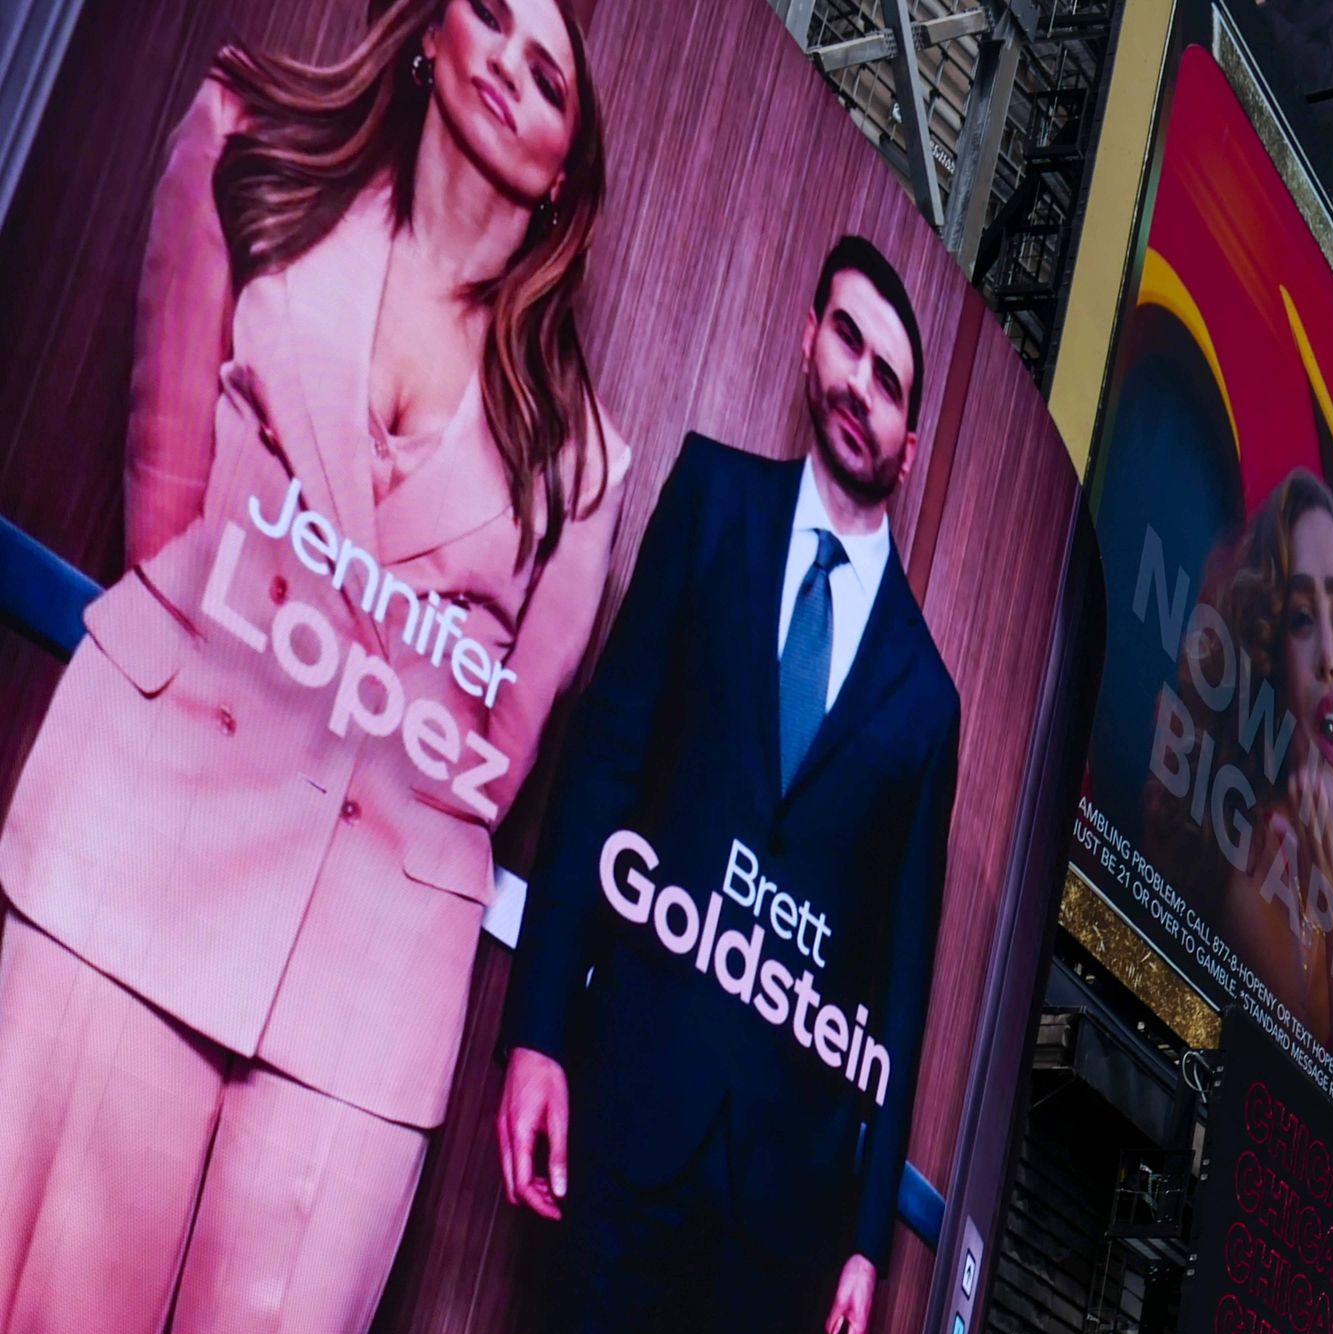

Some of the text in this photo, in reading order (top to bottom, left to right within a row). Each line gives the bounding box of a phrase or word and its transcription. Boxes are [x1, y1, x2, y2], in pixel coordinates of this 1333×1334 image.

[200, 520, 511, 821] Lopez
[249, 477, 518, 709] Jennifer
[1132, 523, 1298, 786] NOW
[1150, 680, 1258, 873] BIG
[599, 829, 891, 1106] Goldstein
[722, 838, 832, 968] Brett
[1100, 846, 1117, 875] BE
[1117, 864, 1131, 889] 21
[1132, 881, 1150, 910] OR
[1150, 899, 1180, 940] OVER
[1180, 928, 1196, 954] TO
[1195, 945, 1238, 999] GAMBLE.
[1290, 1043, 1330, 1098] MESSAGE
[1131, 849, 1187, 917] PROBLEM?
[1186, 909, 1212, 946] CALL
[1212, 935, 1278, 1011] 877-8-HOPENY
[1277, 1003, 1292, 1026] OR
[1291, 1016, 1313, 1047] TEXT
